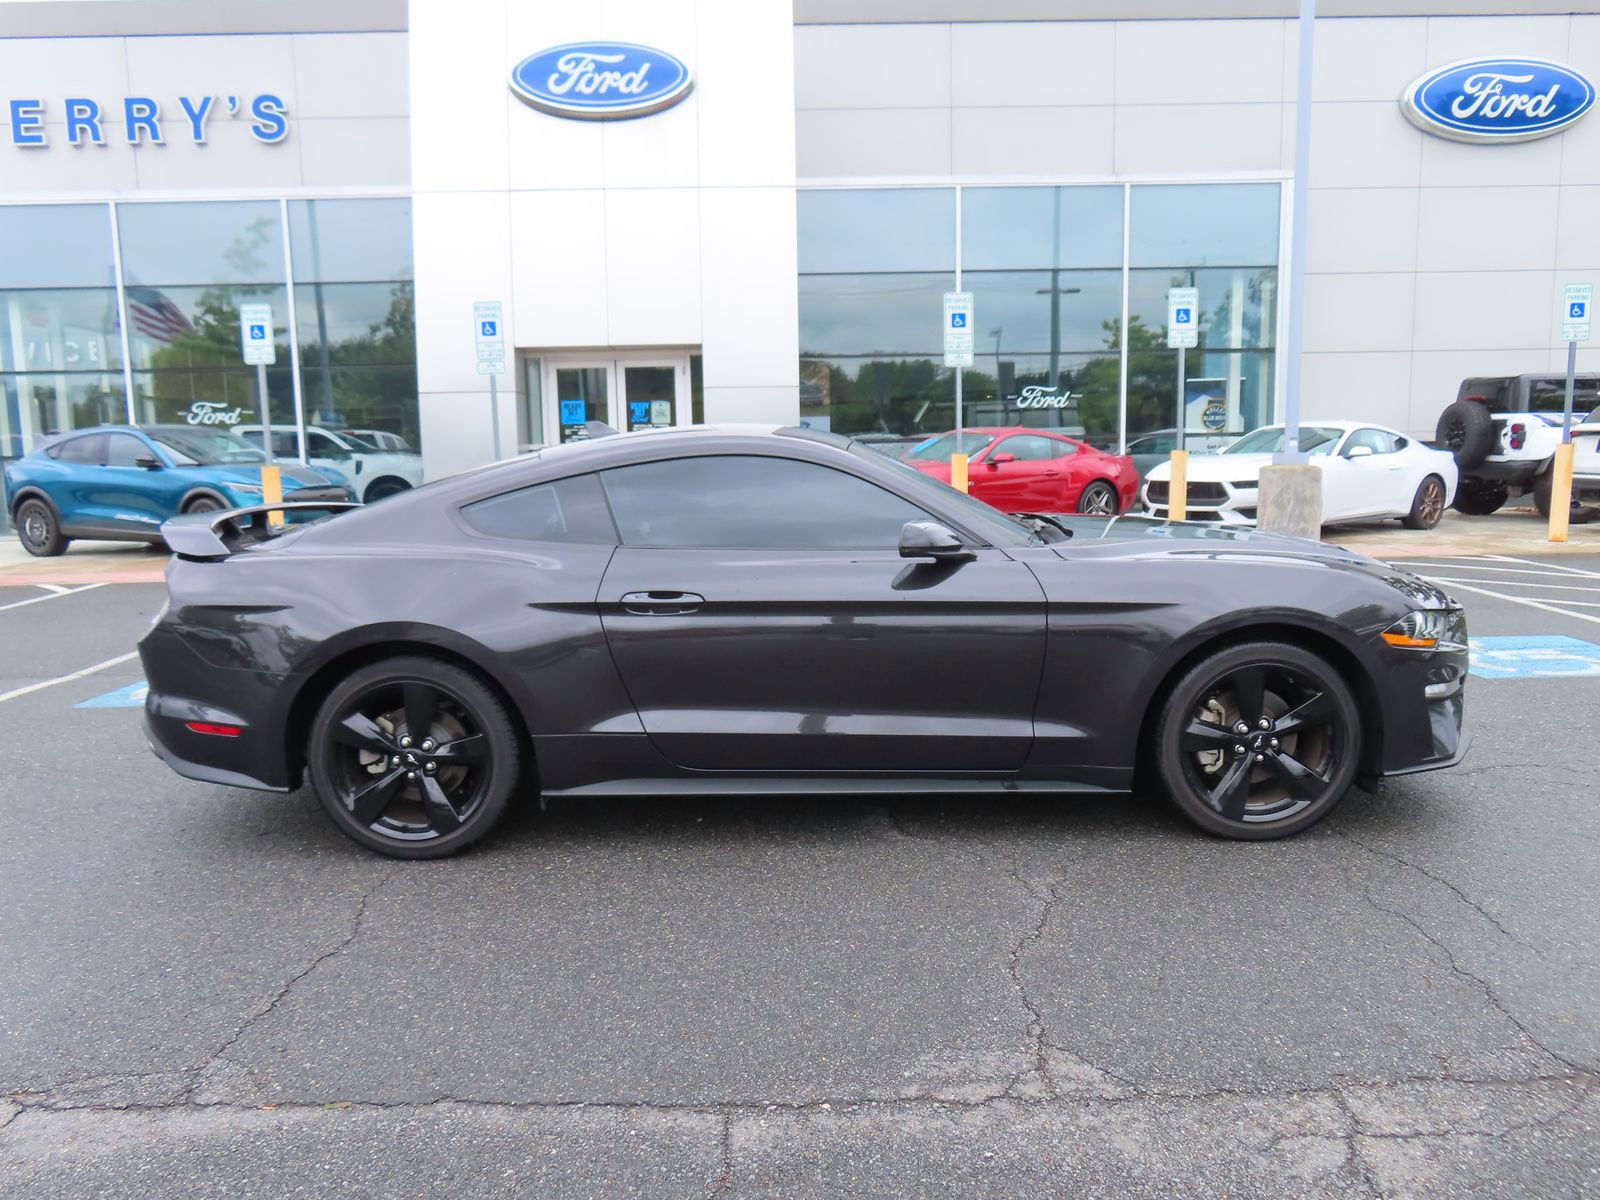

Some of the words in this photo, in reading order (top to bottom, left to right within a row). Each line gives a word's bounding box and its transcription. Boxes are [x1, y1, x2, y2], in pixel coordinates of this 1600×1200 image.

[547, 52, 651, 95] Ford
[1451, 73, 1560, 119] Ford
[9, 94, 288, 149] ERRY'S
[187, 401, 242, 425] Ford
[1016, 385, 1071, 409] Ford
